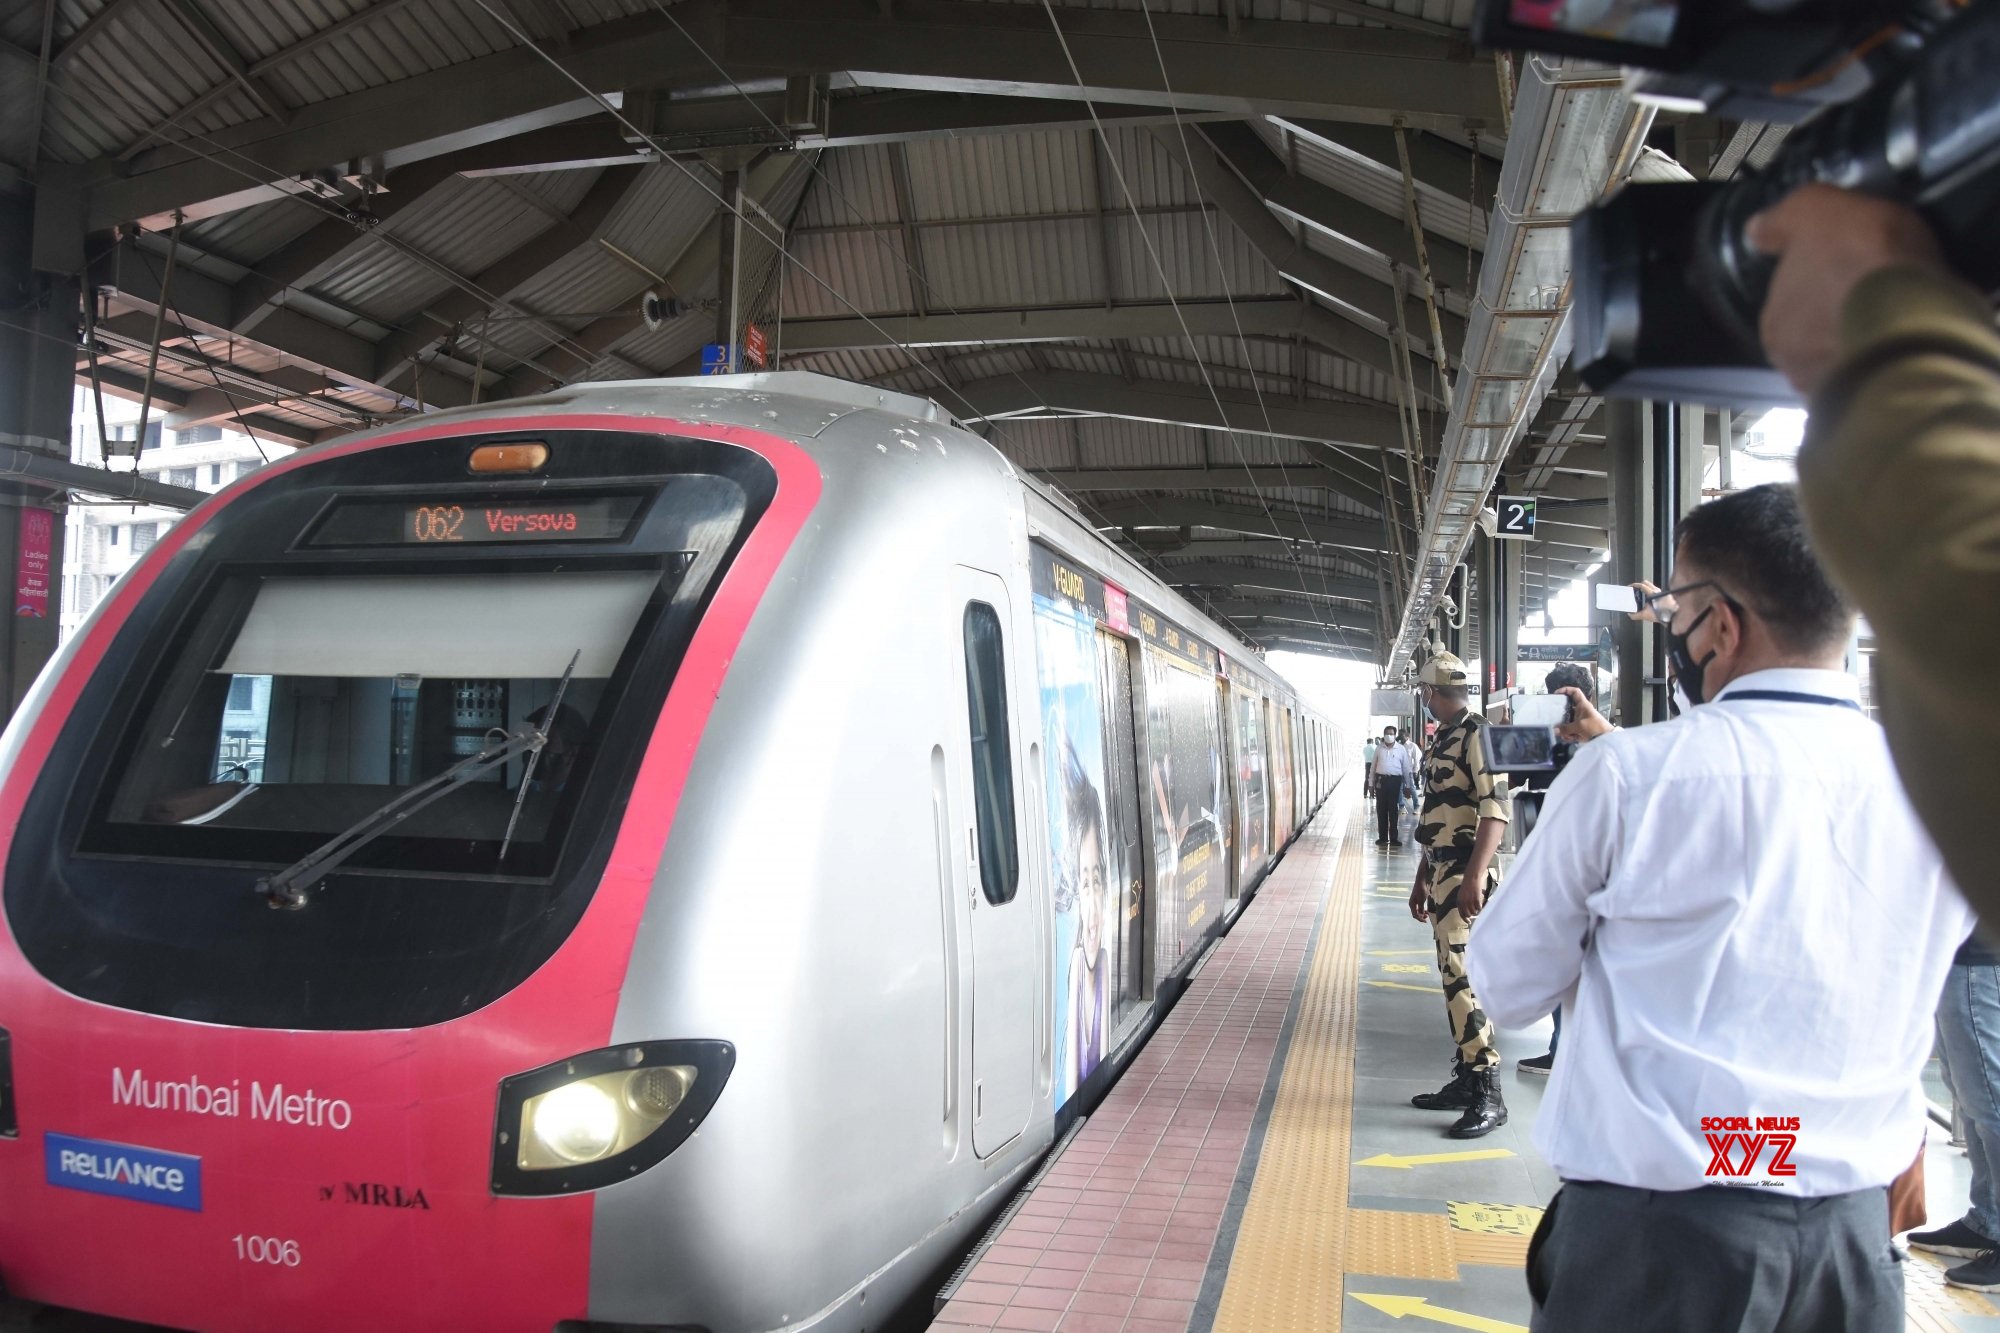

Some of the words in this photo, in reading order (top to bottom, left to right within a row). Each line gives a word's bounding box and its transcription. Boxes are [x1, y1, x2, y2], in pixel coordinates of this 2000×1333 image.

[717, 345, 726, 362] 3
[415, 506, 465, 541] 062
[486, 510, 577, 532] Versova
[1506, 504, 1525, 530] 2
[25, 549, 49, 560] Ladies
[28, 560, 44, 570] only
[1052, 561, 1085, 602] V-GUARD
[1566, 647, 1574, 659] 2
[113, 1067, 240, 1117] Mumbai
[251, 1081, 352, 1130] Metro
[232, 1233, 301, 1267] 1006
